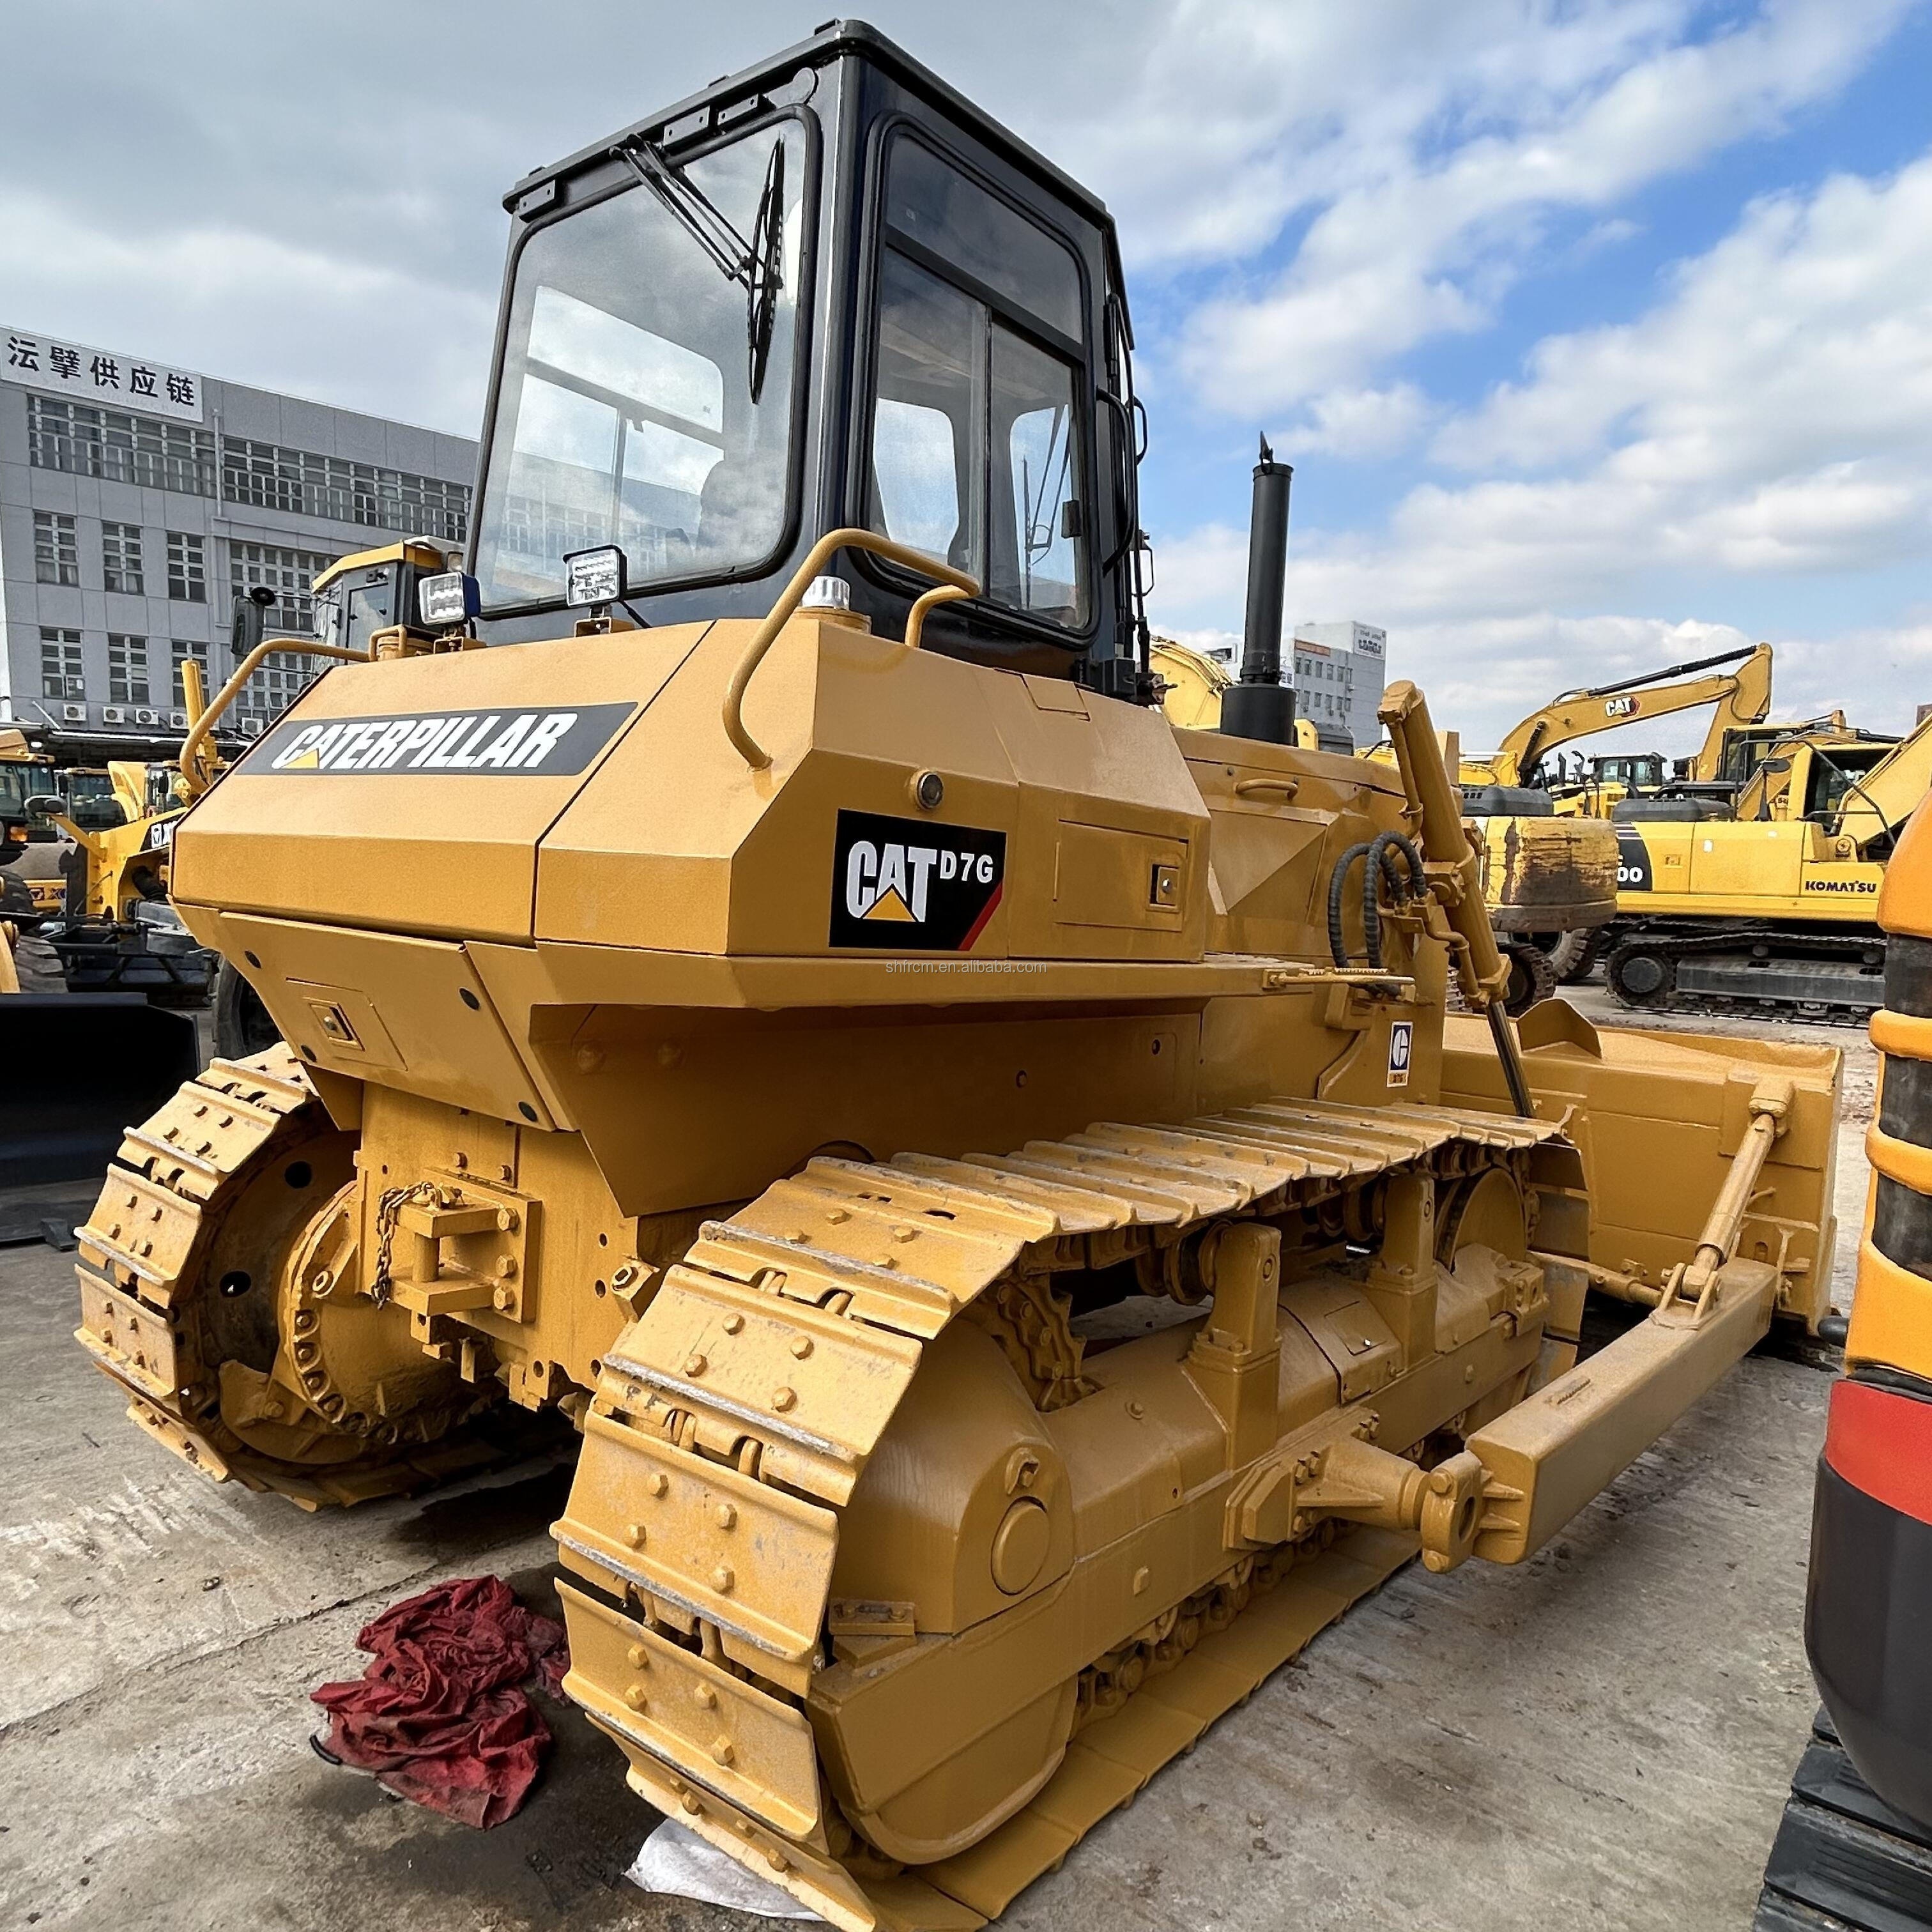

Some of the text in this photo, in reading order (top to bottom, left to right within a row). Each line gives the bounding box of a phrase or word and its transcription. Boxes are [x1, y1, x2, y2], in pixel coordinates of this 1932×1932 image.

[1605, 696, 1632, 717] CAT
[271, 712, 578, 769] CATERPILLAR
[846, 840, 993, 923] CAT D7G
[1805, 880, 1877, 893] KOMATSU
